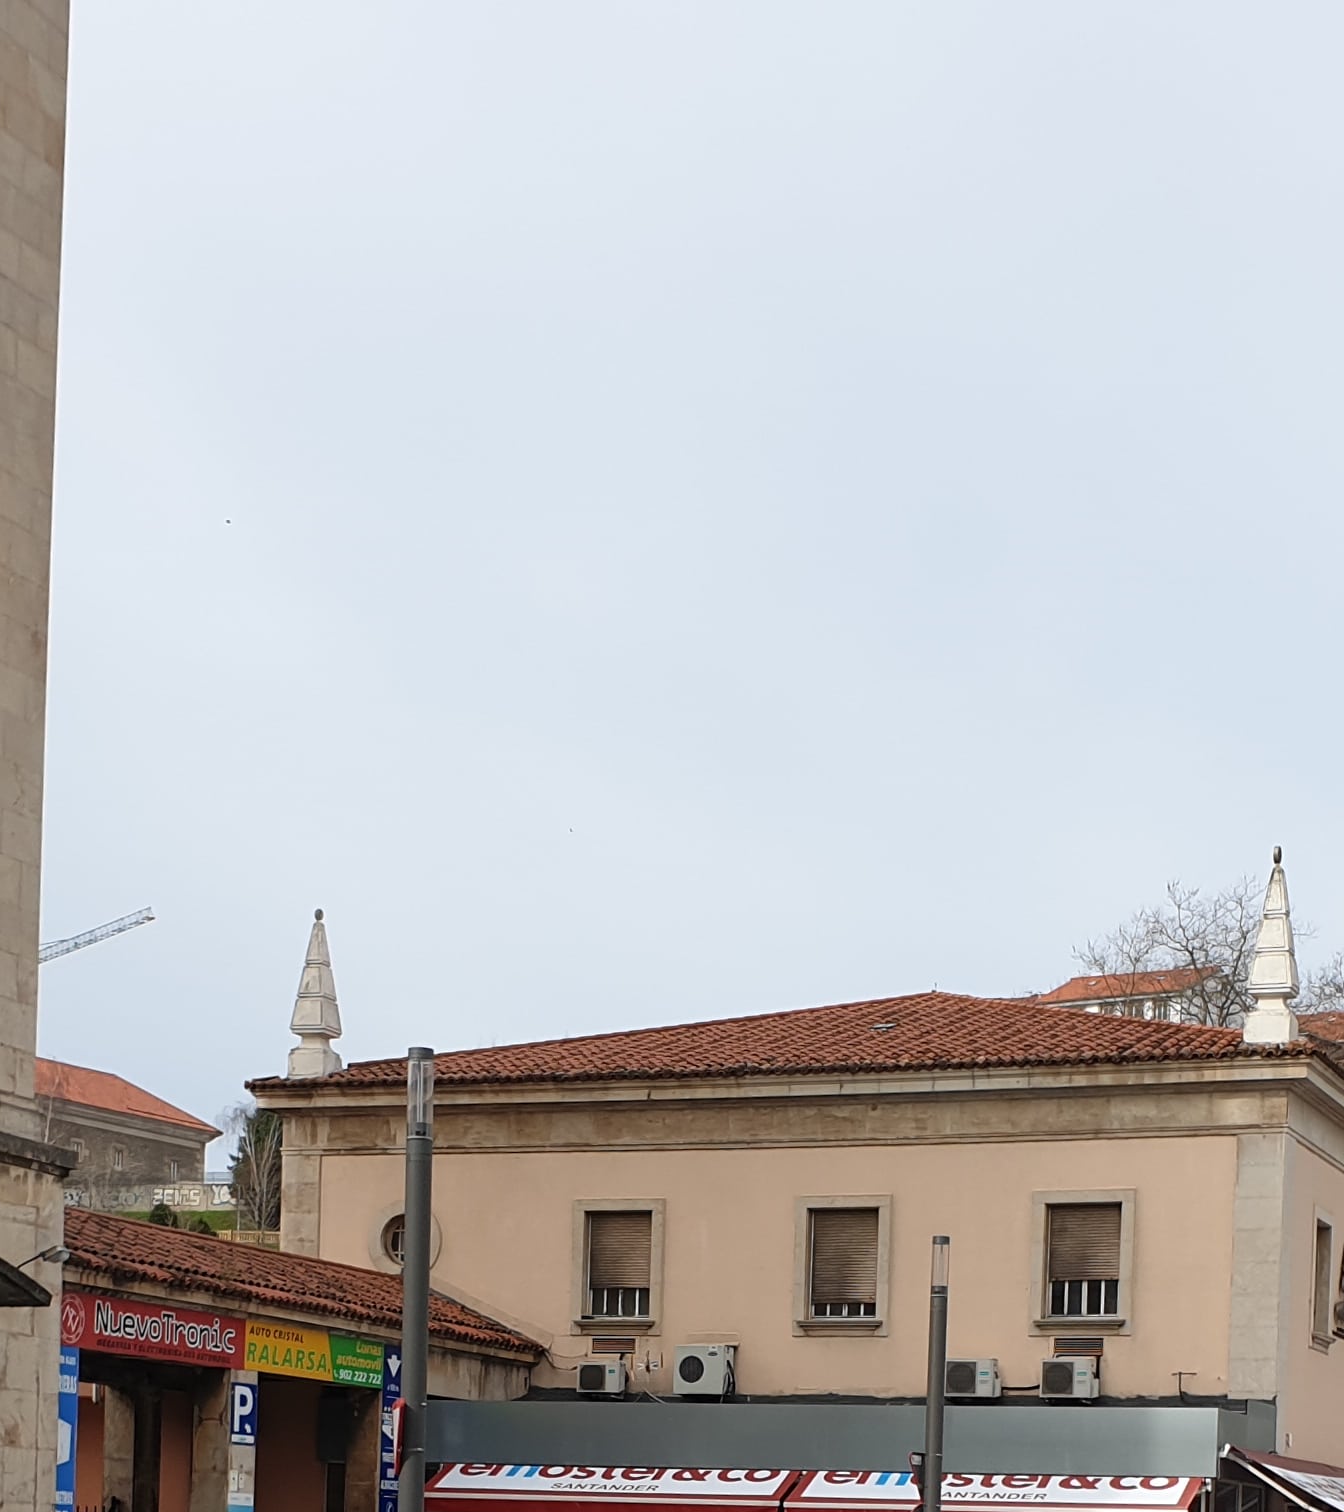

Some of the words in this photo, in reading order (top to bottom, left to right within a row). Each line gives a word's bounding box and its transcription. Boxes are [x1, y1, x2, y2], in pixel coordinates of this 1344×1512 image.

[94, 1300, 235, 1353] NuevoTronic
[249, 1325, 271, 1338] AUTO
[273, 1329, 304, 1344] CRISTAL
[233, 1385, 254, 1433] P
[551, 1482, 659, 1492] SANTANDER
[942, 1491, 1048, 1500] ANTANDER
